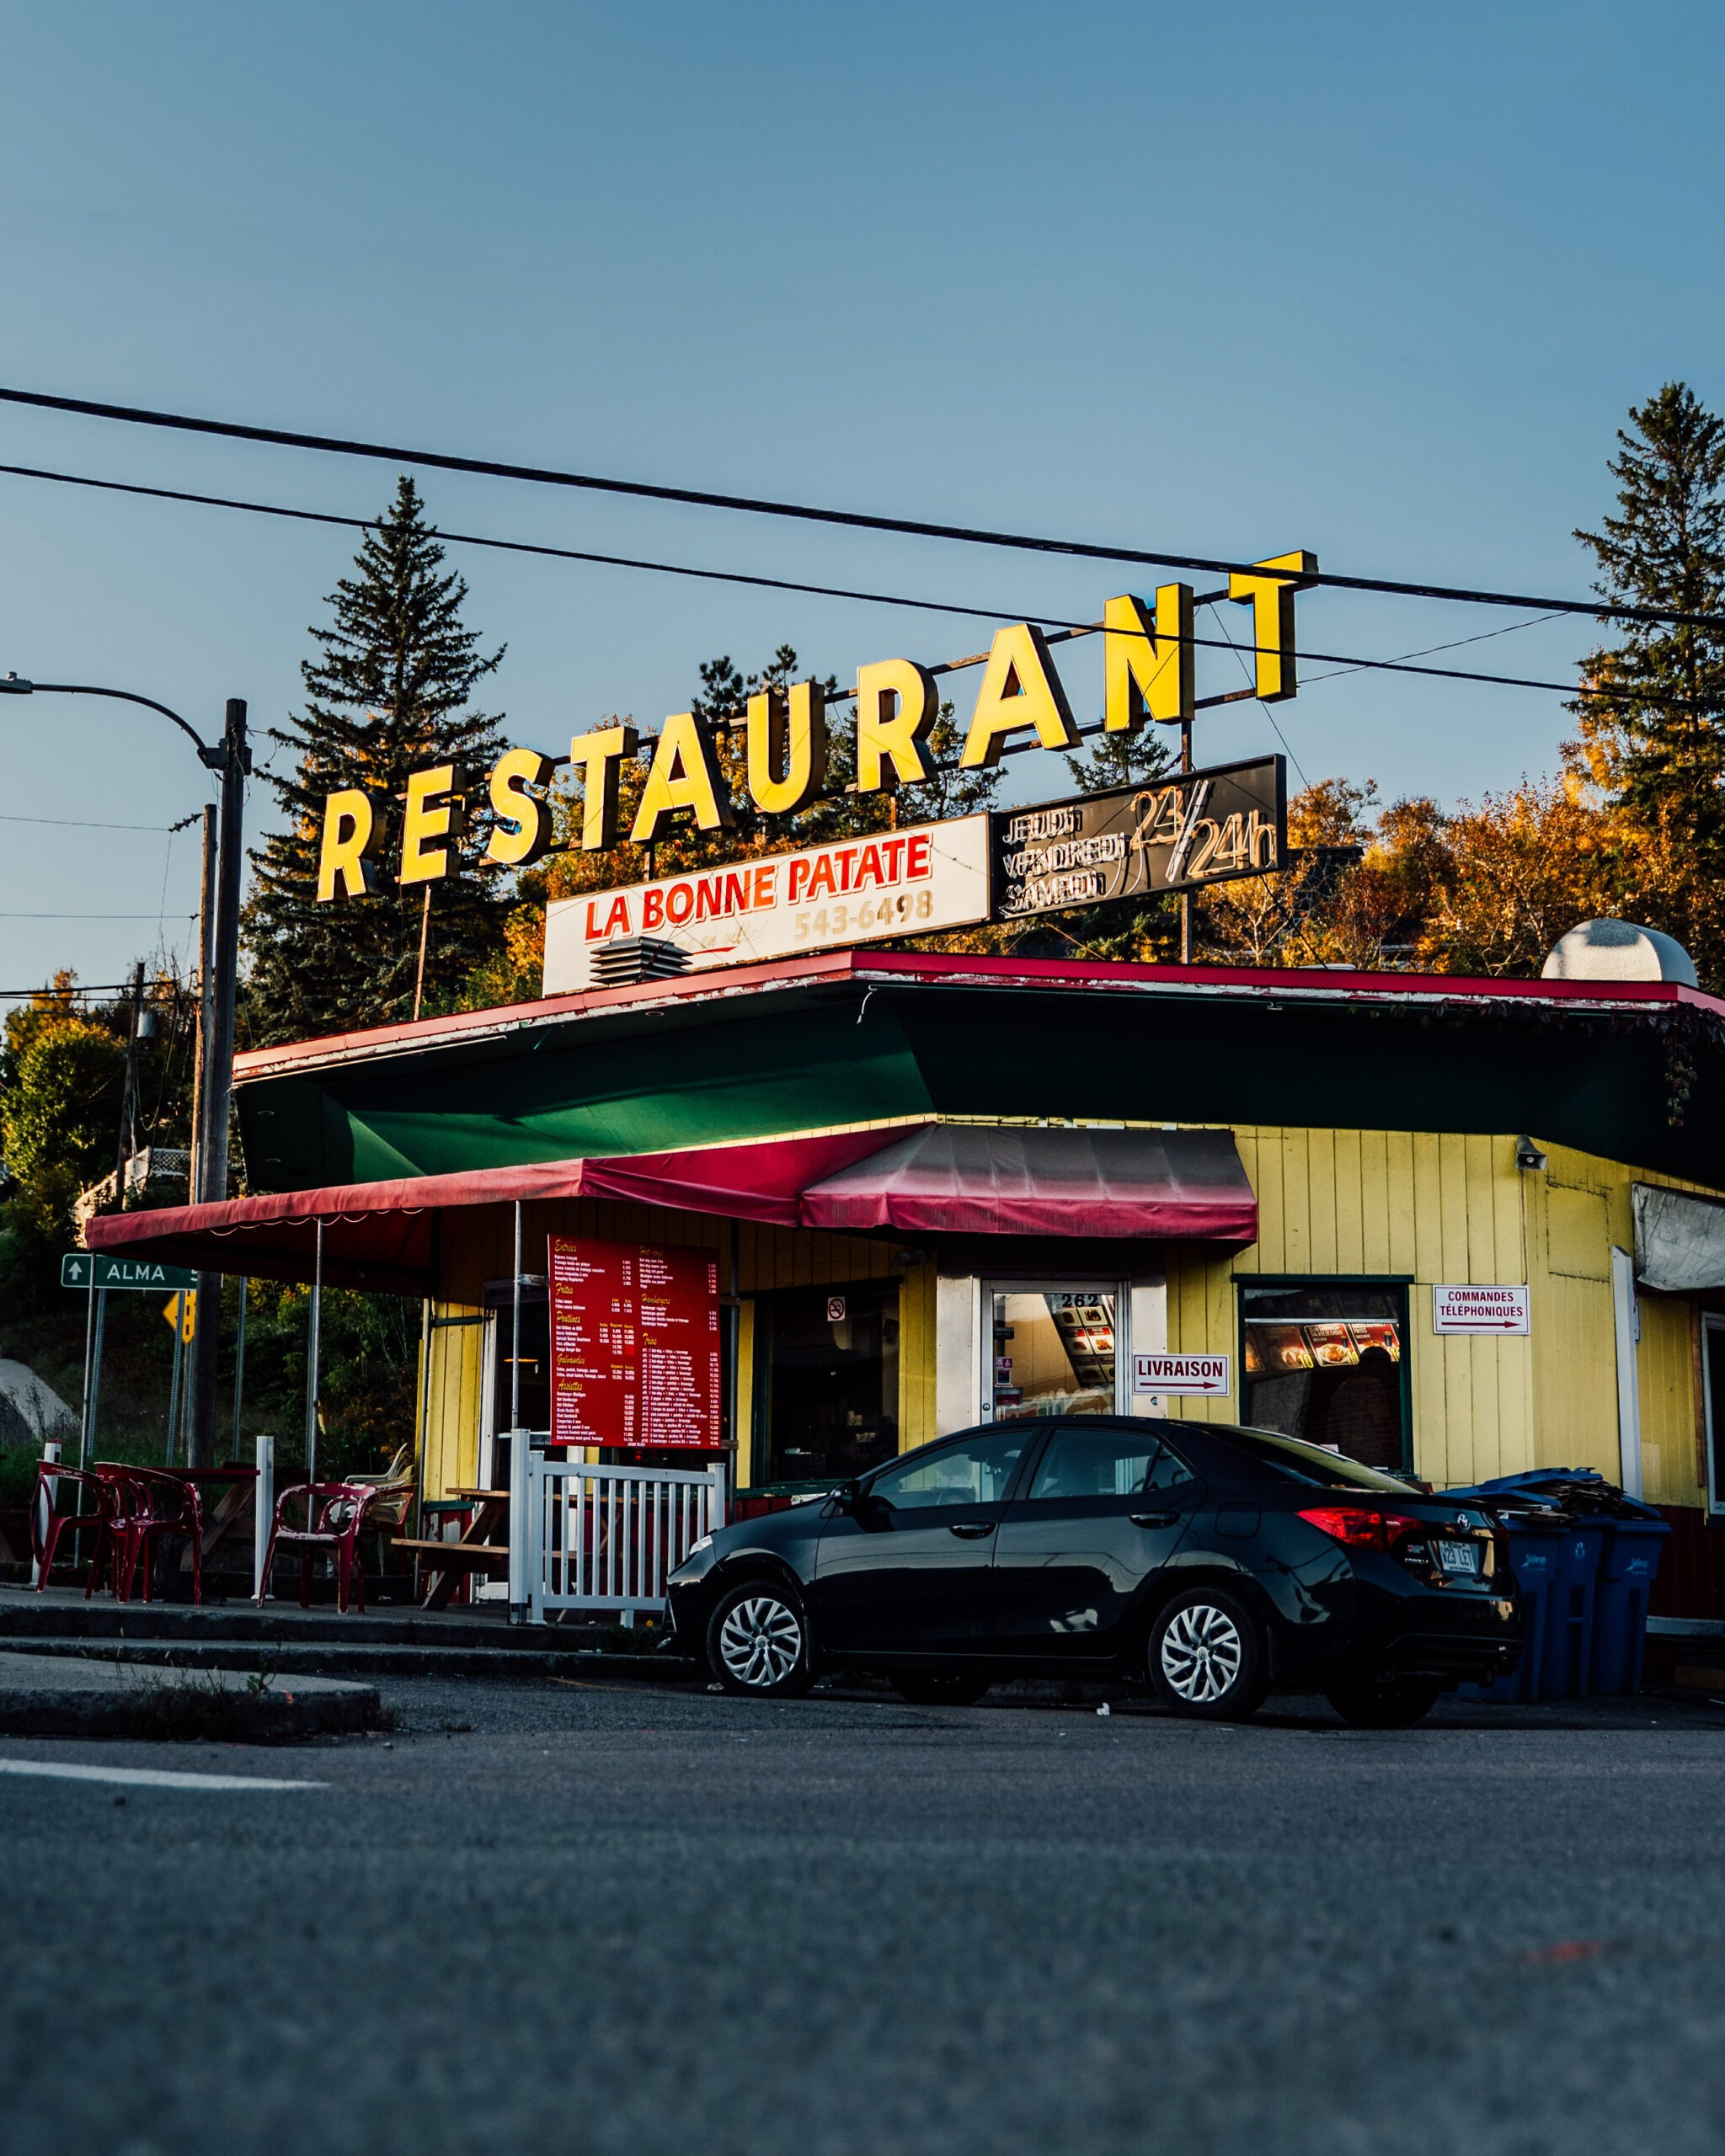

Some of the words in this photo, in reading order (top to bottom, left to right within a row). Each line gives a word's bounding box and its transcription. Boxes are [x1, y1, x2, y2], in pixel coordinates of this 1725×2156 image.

[317, 549, 1316, 902] RESTAURANT
[585, 894, 633, 944] LA
[642, 863, 777, 932] BONNE
[788, 833, 933, 904] PATATE
[793, 889, 935, 942] 543-6498
[106, 1264, 165, 1281] ALMA
[1062, 1294, 1098, 1307] 262
[1448, 1291, 1514, 1302] COMMANDES
[1439, 1303, 1524, 1317] TÉLÉPHONIQUES
[1137, 1358, 1224, 1379] LIVRAISON
